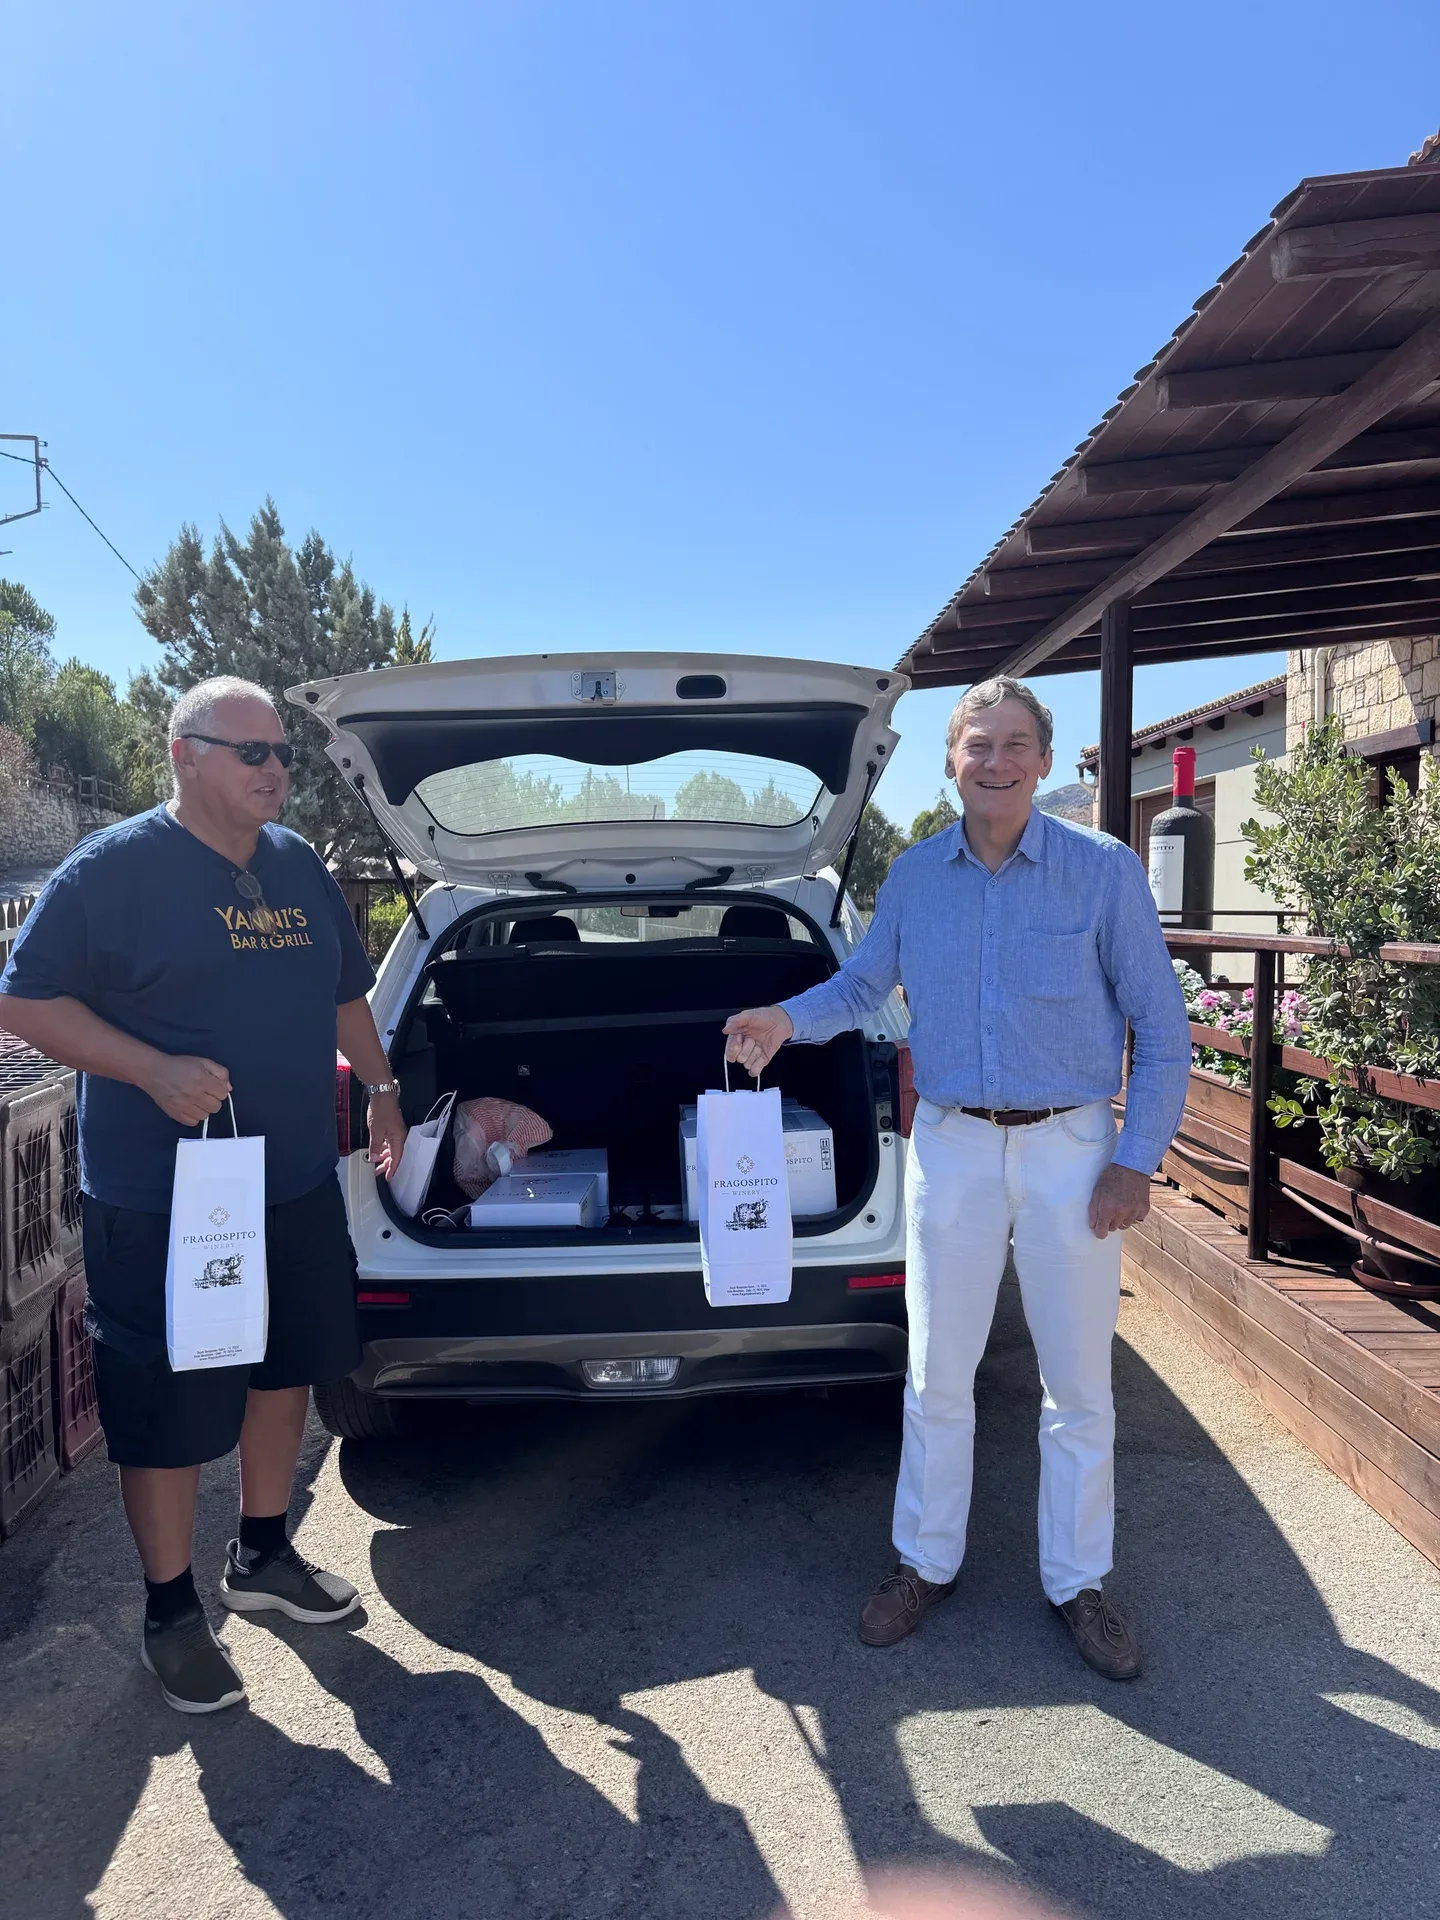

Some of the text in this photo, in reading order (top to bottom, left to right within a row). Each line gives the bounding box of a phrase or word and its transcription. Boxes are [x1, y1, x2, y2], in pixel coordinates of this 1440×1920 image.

[213, 905, 308, 931] YANNI'S
[230, 932, 313, 949] BAR & GRILL
[714, 1177, 778, 1188] FRAGOSPITO
[182, 1230, 256, 1244] FRAGOSPITO
[203, 1242, 236, 1250] WINERY
